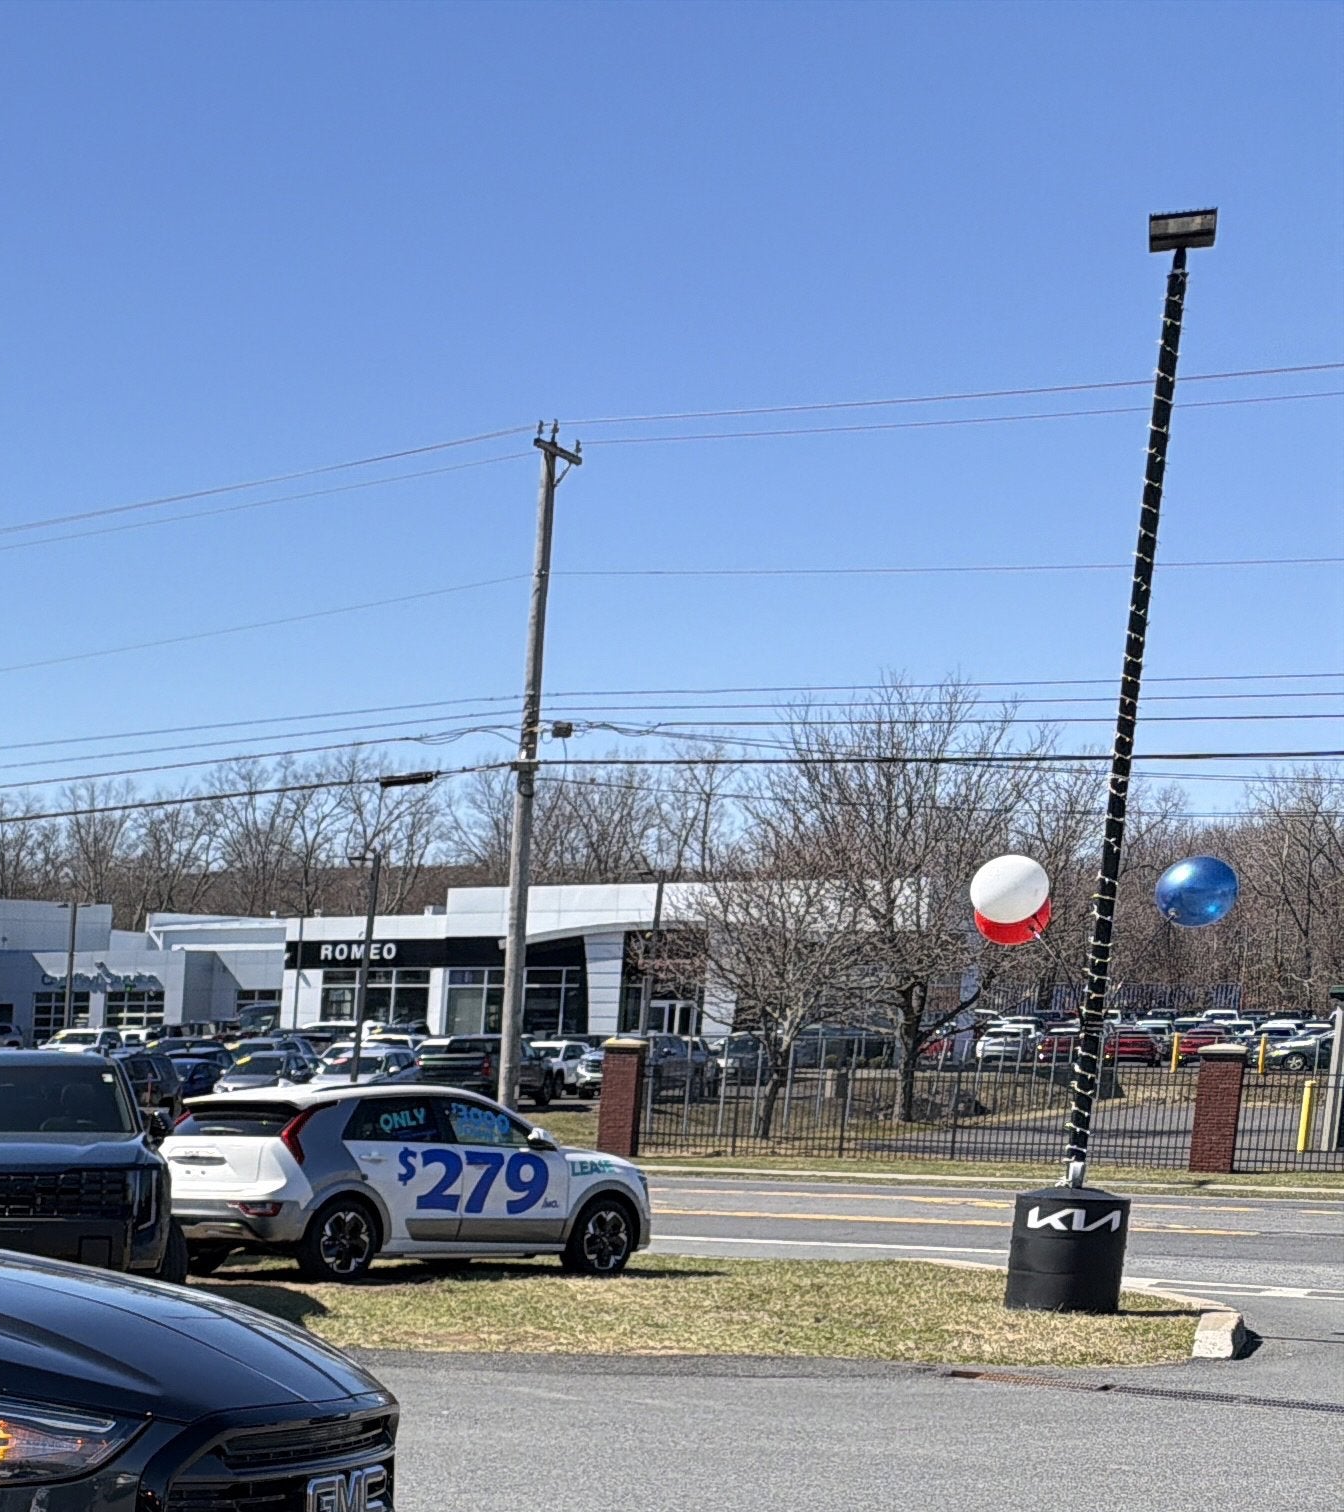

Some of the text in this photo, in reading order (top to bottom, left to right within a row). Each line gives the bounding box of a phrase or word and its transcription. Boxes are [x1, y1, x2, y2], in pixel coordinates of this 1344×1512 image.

[320, 943, 397, 961] ROMEO
[379, 1107, 425, 1132] ONLY
[398, 1147, 549, 1215] $279
[1026, 1205, 1122, 1233] KIA
